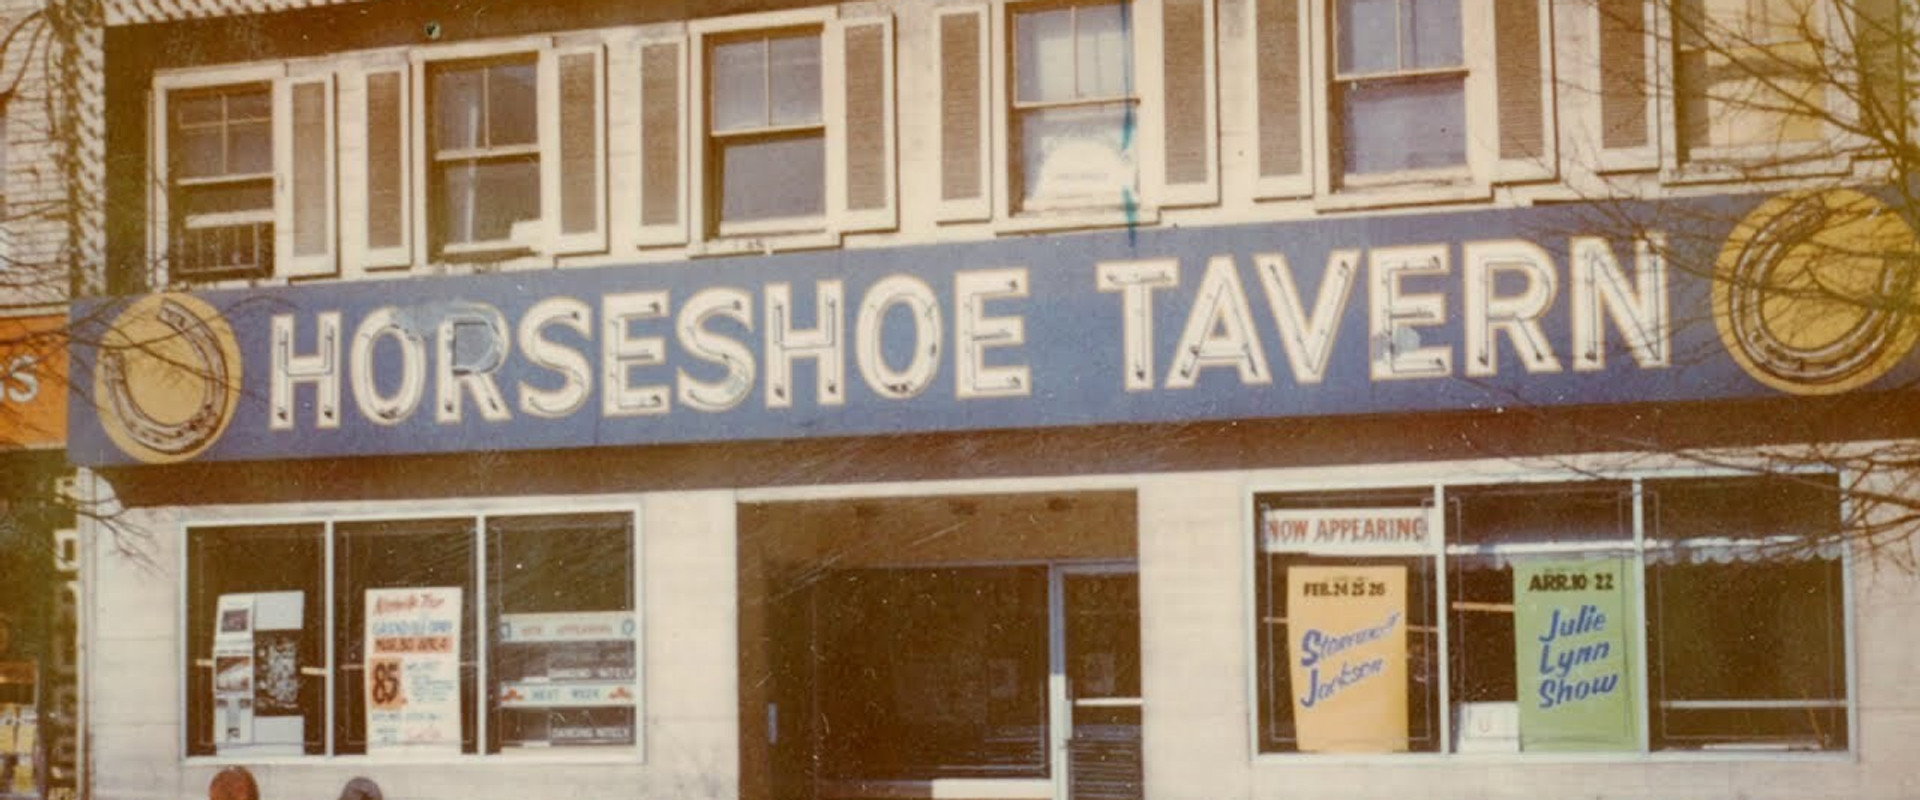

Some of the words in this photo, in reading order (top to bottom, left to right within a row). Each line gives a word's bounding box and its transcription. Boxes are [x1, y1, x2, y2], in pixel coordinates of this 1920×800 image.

[268, 267, 1032, 430] HORSESHOE
[1096, 231, 1671, 392] TAVERN
[0, 355, 38, 402] S
[1268, 520, 1309, 542] NOW
[1314, 517, 1428, 542] APPEARING
[1538, 604, 1607, 642] Julie
[1540, 642, 1611, 678] Lynn
[1539, 673, 1619, 709] Show
